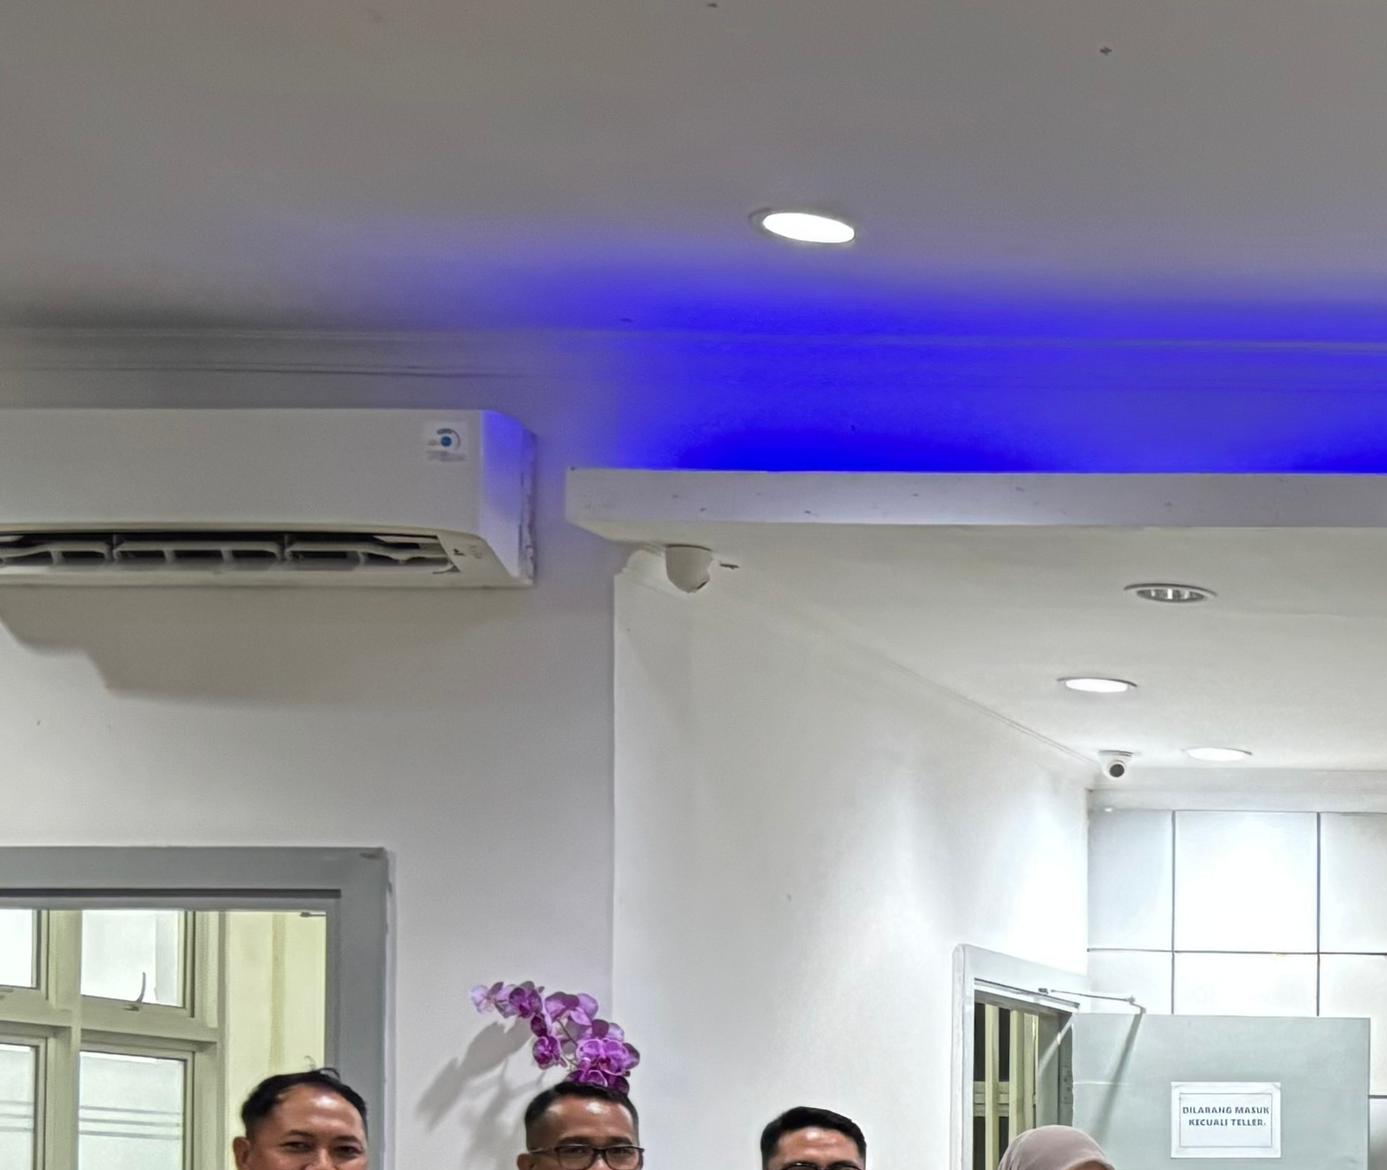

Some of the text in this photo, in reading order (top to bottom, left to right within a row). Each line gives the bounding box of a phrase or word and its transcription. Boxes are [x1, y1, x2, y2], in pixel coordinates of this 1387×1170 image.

[1182, 1106, 1270, 1115] DILARANG MASUK
[1188, 1118, 1228, 1127] KECUALI
